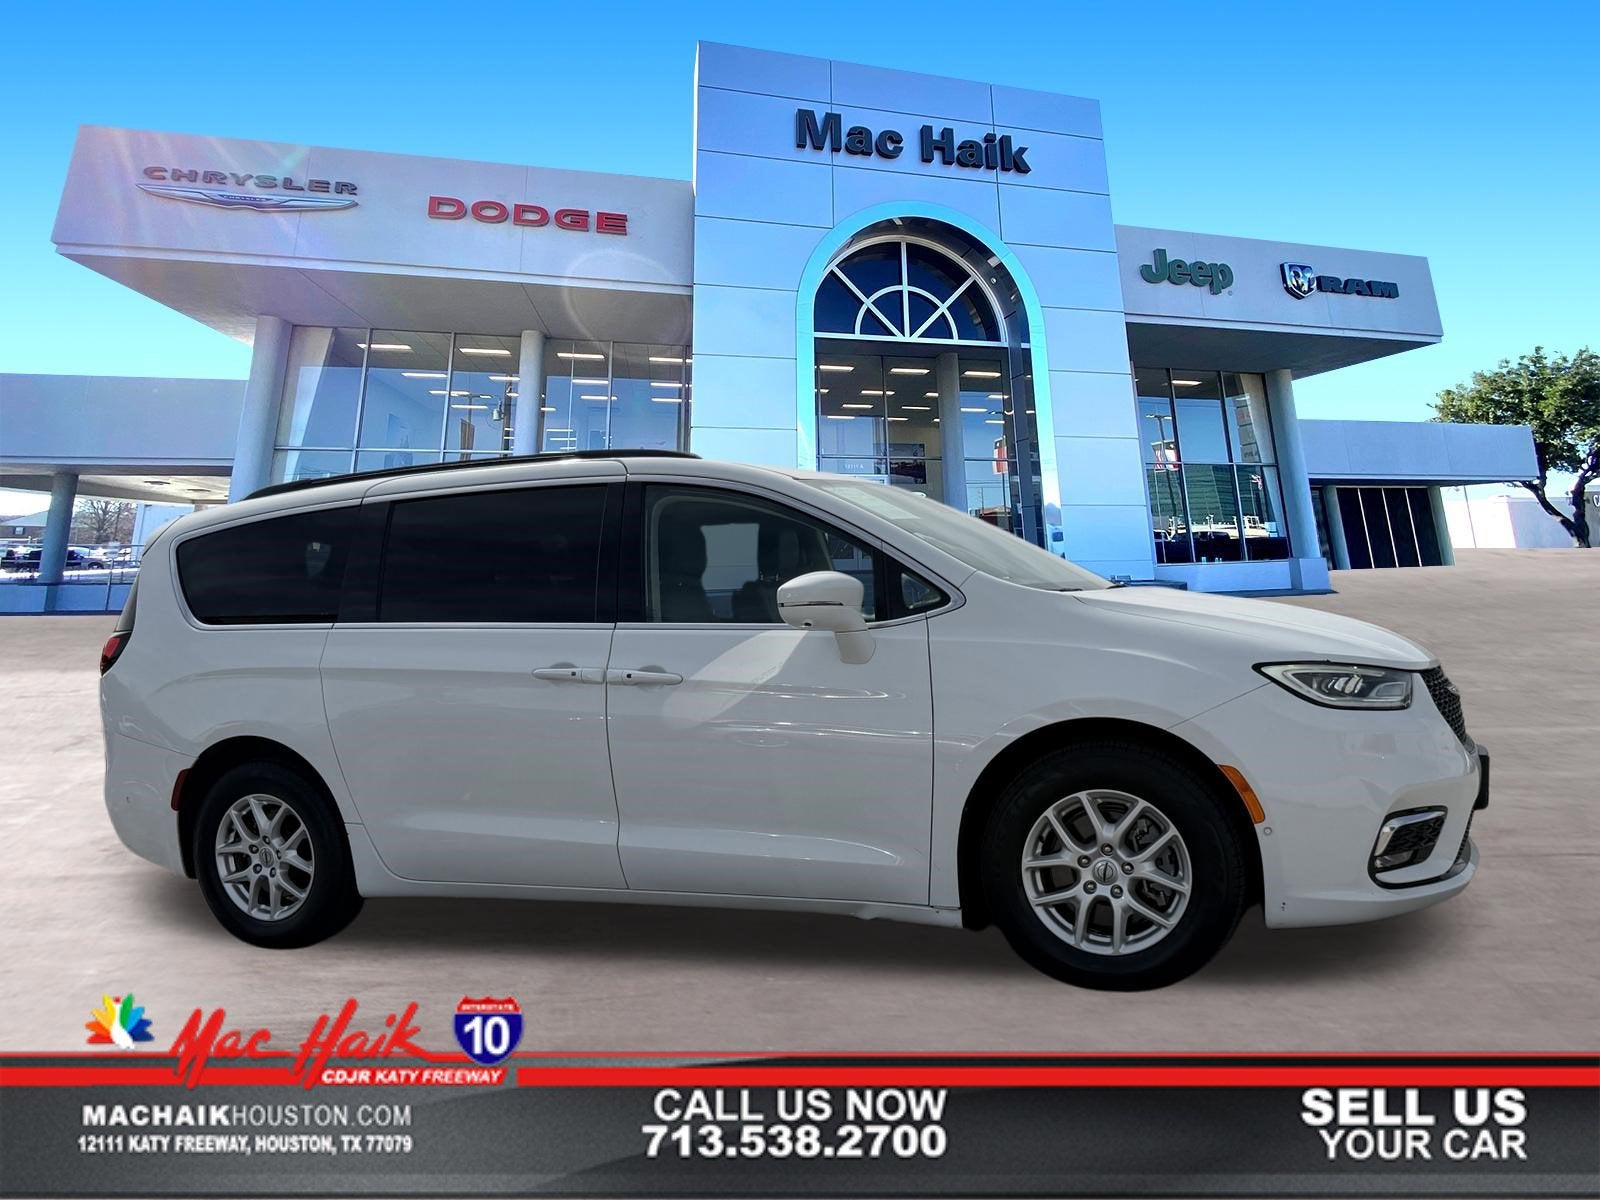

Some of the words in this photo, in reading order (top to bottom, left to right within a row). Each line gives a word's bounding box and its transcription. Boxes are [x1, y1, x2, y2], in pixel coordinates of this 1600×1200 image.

[796, 108, 904, 160] Mac
[919, 124, 1032, 174] Haik
[143, 166, 358, 196] CHRYSLER
[427, 195, 628, 236] DODGE
[1139, 248, 1234, 295] Jeep
[1316, 275, 1400, 299] RAM
